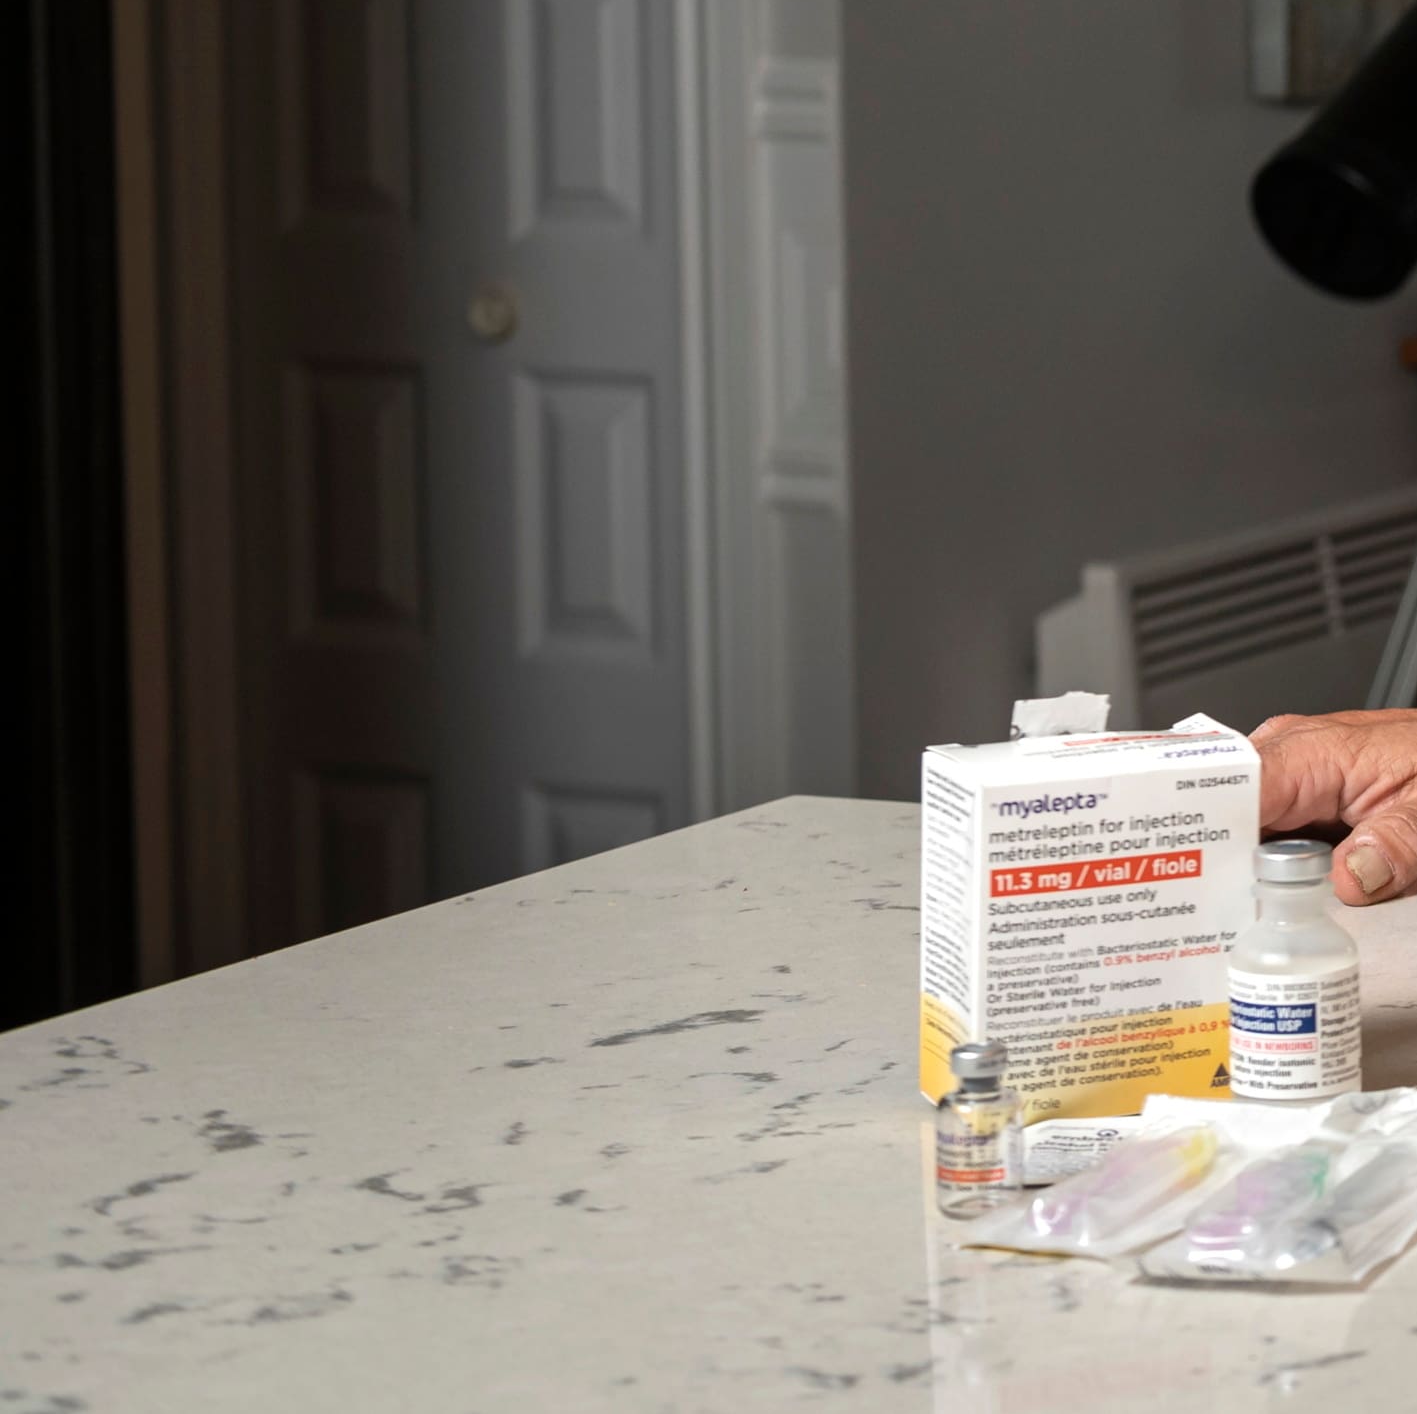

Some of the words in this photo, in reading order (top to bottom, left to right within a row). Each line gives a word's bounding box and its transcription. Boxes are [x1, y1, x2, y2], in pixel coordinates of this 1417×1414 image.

[1176, 780, 1196, 790] DIN
[989, 822, 1094, 844] metreleptin
[1099, 818, 1124, 834] for
[1129, 811, 1205, 832] injection
[989, 839, 1104, 863] métréleptine
[1109, 836, 1150, 854] pour
[1155, 827, 1230, 848] injection
[994, 872, 1033, 892] 11.3
[1038, 870, 1072, 891] mg
[1077, 865, 1090, 886] /
[1094, 859, 1131, 882] vial
[1135, 859, 1148, 880] /
[1152, 856, 1198, 876] fiole
[988, 894, 1093, 917] Subcutaneous
[1097, 892, 1122, 905] use
[1126, 888, 1158, 905] only
[989, 913, 1098, 935] Administration
[1100, 902, 1196, 924] sous-cutanée
[987, 950, 1064, 967] Reconstitute
[1068, 946, 1093, 959] with
[1096, 936, 1178, 956] Bacteriostatic
[1182, 933, 1217, 947] Water
[1220, 929, 1237, 941] for
[988, 933, 1065, 951] seulement
[987, 965, 1041, 980] Injection
[1044, 958, 1100, 975] (contains
[1103, 953, 1133, 967] 0.9%
[1136, 948, 1176, 964] benzyl
[1179, 944, 1221, 959] alcohol
[986, 994, 1002, 1004] Or
[1006, 988, 1045, 1002] Sterile
[1050, 985, 1086, 999] Water
[1089, 982, 1107, 994] for
[1109, 976, 1163, 992] Injection
[997, 973, 1079, 992] preservative)
[986, 1001, 1067, 1019] (preservative
[1071, 996, 1101, 1011] free)
[1080, 1008, 1124, 1024] produit
[1127, 1005, 1154, 1017] avec
[1157, 1001, 1172, 1013] de
[1090, 1022, 1119, 1036] pour
[1122, 1015, 1173, 1032] injection
[1005, 1041, 1053, 1056] ntenant
[1056, 1039, 1072, 1051] de
[1121, 1027, 1186, 1044] benzylique
[1034, 1052, 1067, 1068] agent
[1070, 1050, 1089, 1062] de
[1092, 1040, 1174, 1060] conservation)
[1007, 1069, 1035, 1081] avec
[1038, 1066, 1055, 1078] de
[1090, 1056, 1127, 1072] stérile
[1129, 1054, 1158, 1070] pour
[1161, 1047, 1212, 1064] injection
[1021, 1079, 1057, 1094] agent
[1059, 1075, 1076, 1088] de
